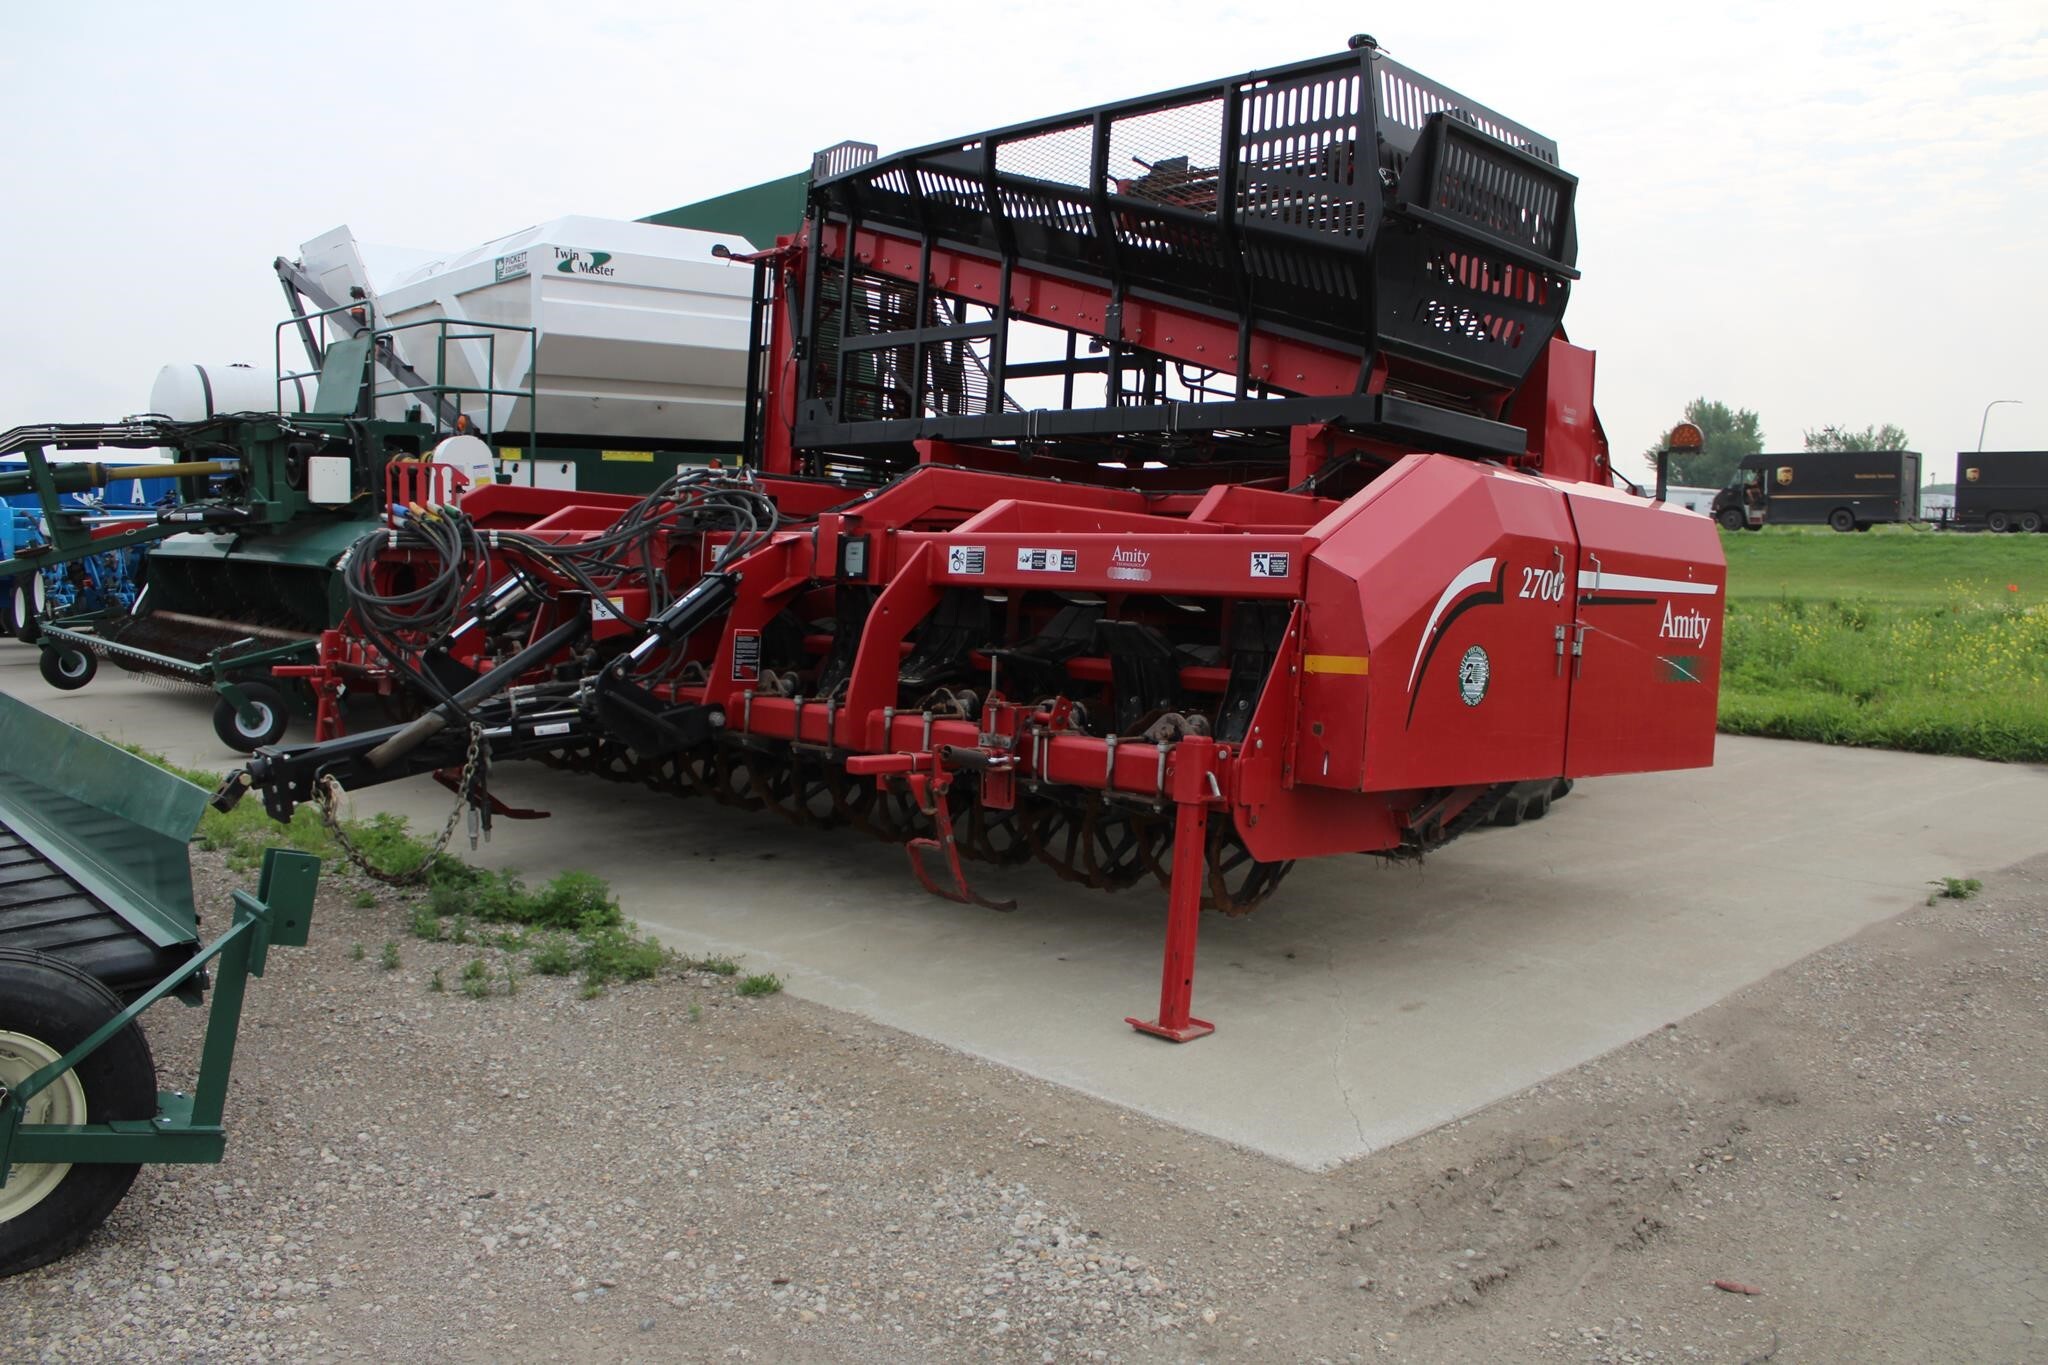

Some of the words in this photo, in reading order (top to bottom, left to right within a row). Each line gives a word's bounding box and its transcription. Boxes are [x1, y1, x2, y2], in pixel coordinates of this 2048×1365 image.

[504, 251, 528, 265] PICKETT
[553, 247, 579, 260] Twin
[578, 261, 614, 276] Master
[1112, 545, 1150, 567] Amity
[1659, 600, 1711, 649] Amity
